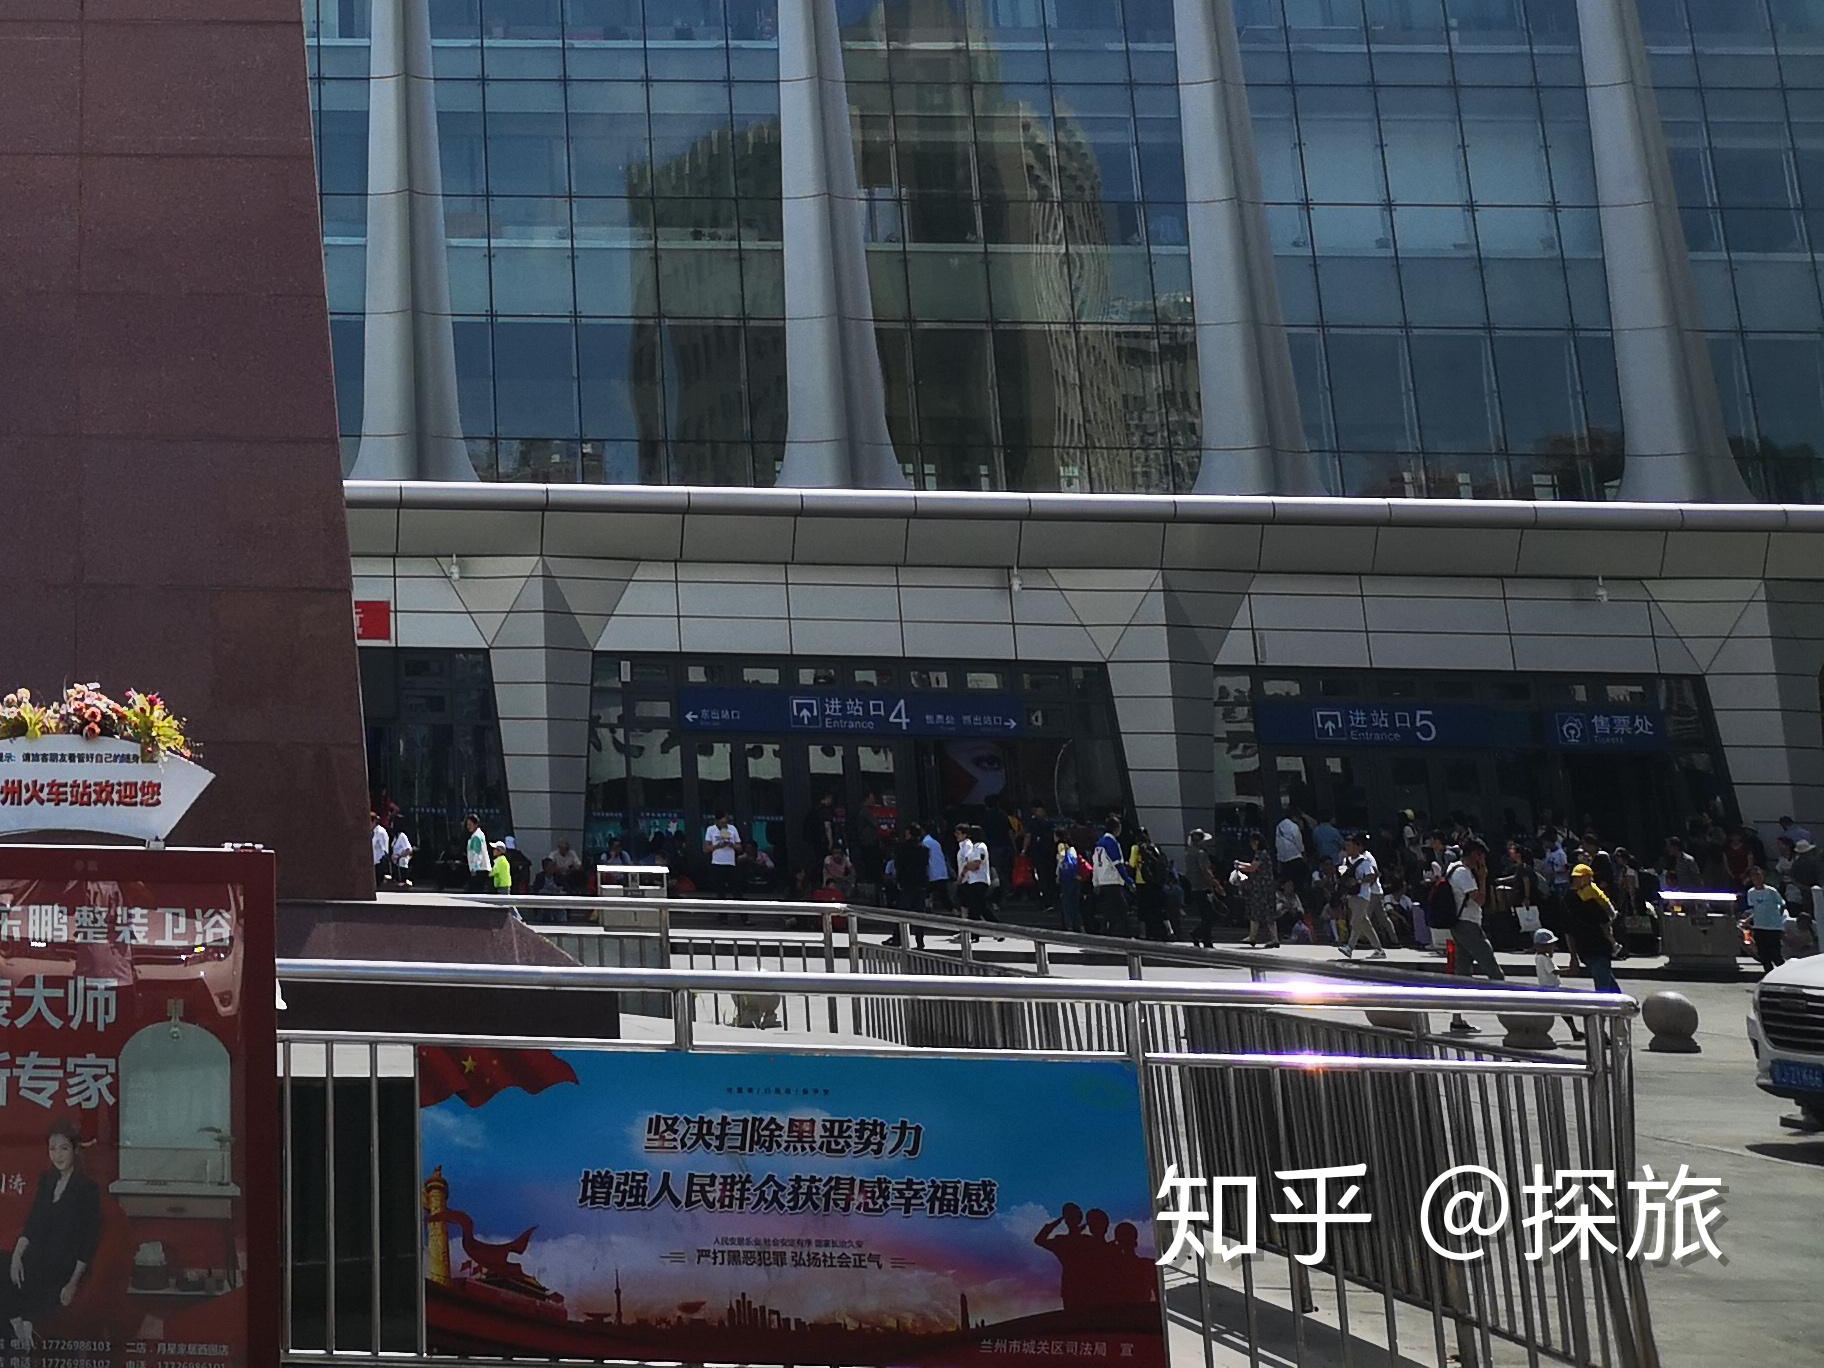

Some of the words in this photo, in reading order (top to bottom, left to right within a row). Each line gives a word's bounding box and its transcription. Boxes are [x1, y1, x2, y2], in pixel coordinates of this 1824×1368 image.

[825, 697, 885, 717] 进站口
[888, 699, 910, 730] 4
[825, 718, 875, 730] Entrance
[1348, 710, 1412, 730] 进站口
[1415, 710, 1437, 742] 5
[1591, 714, 1654, 736] 售票处
[1350, 731, 1401, 742] Entrance
[643, 1114, 924, 1158] 坚决扫除黑恶势力
[578, 1170, 998, 1218] 增强人民群众获得感幸福感
[696, 1249, 787, 1268] 严打黑恶犯罪
[791, 1251, 883, 1270] 弘扬社会正气
[980, 1338, 1107, 1357] 兰州市城关区司法局
